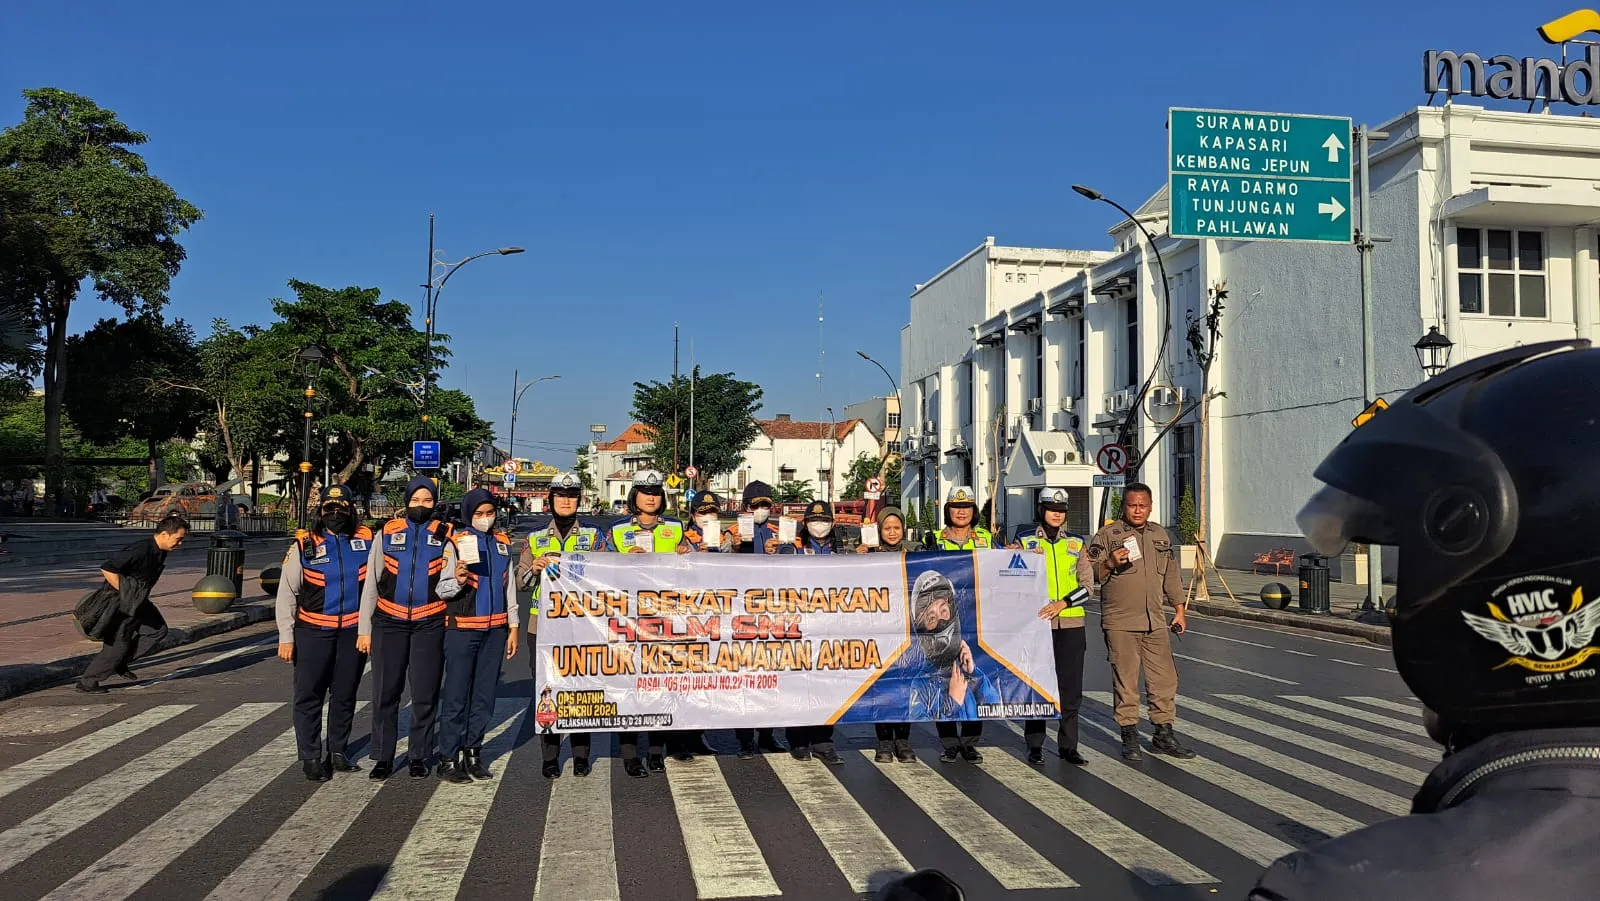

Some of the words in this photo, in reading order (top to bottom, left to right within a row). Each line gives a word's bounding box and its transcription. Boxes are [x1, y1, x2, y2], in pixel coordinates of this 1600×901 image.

[1196, 115, 1291, 133] SURAMADU
[1200, 135, 1287, 153] KAPASARI
[1176, 154, 1250, 171] KEMBANG
[1261, 158, 1310, 174] JEPUN
[1188, 178, 1230, 193] RAYA
[1241, 180, 1298, 196] DARMO
[1192, 198, 1295, 216] TUNJUNGAN
[1196, 219, 1289, 236] PAHLAWAN
[546, 590, 629, 618] JAUH
[637, 588, 737, 617] DEKAT
[744, 587, 889, 614] GUNAKAN
[1507, 588, 1558, 615] HVIC
[608, 615, 721, 643] HELM
[731, 614, 802, 641] SNI
[553, 644, 636, 676] UNTUK
[641, 640, 812, 674] KESELAMATAN
[817, 639, 883, 670] ANDA
[1534, 659, 1578, 669] SEMARANG
[637, 676, 660, 691] PASAL
[744, 674, 755, 689] TH
[558, 692, 575, 705] OPS
[577, 691, 604, 704] PATUH
[557, 705, 592, 717] SEMERU
[594, 704, 617, 716] 2024
[977, 704, 1013, 717] DITLANTAS
[1014, 703, 1035, 716] POLDA
[1036, 703, 1055, 715] JATIM
[557, 717, 600, 728] PELAKSANAAN
[601, 717, 612, 727] TGL
[613, 717, 621, 726] 15
